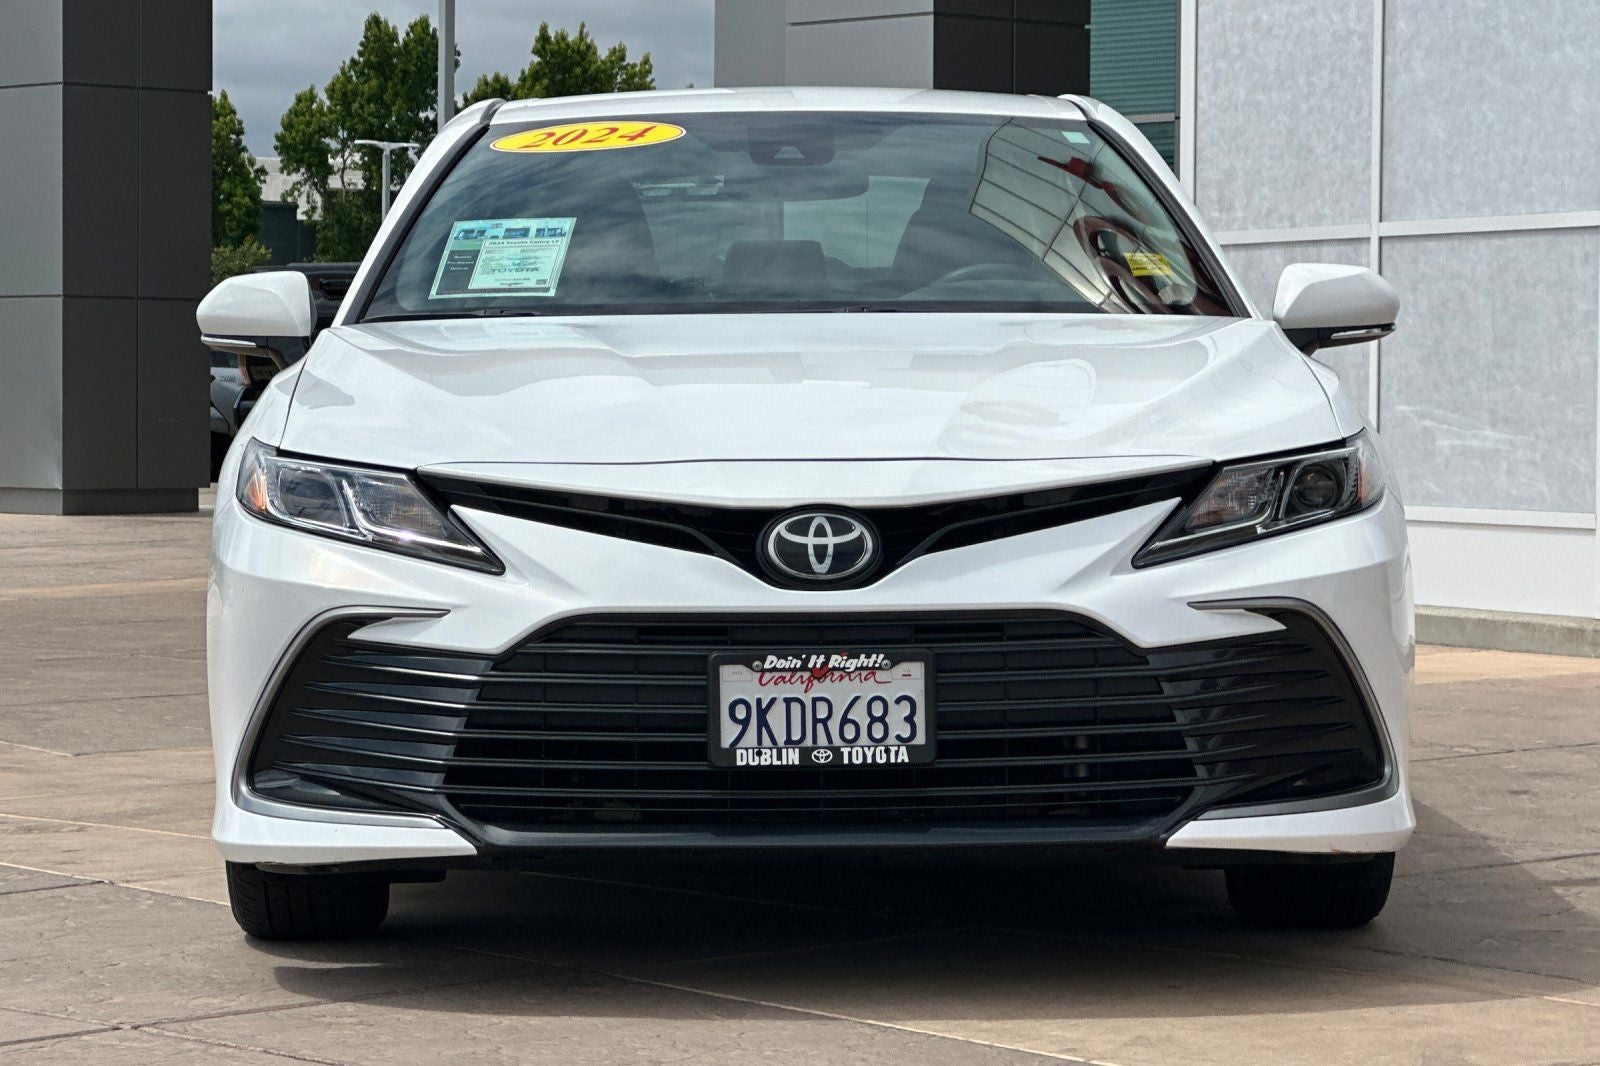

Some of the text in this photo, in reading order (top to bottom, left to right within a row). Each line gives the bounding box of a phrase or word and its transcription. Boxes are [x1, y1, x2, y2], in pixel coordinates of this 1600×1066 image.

[516, 125, 657, 149] 2024
[763, 653, 885, 672] Doin' It Right!
[758, 669, 892, 693] California
[728, 695, 917, 747] 9KDR683
[736, 747, 909, 766] DUBLIN TOYOTA
